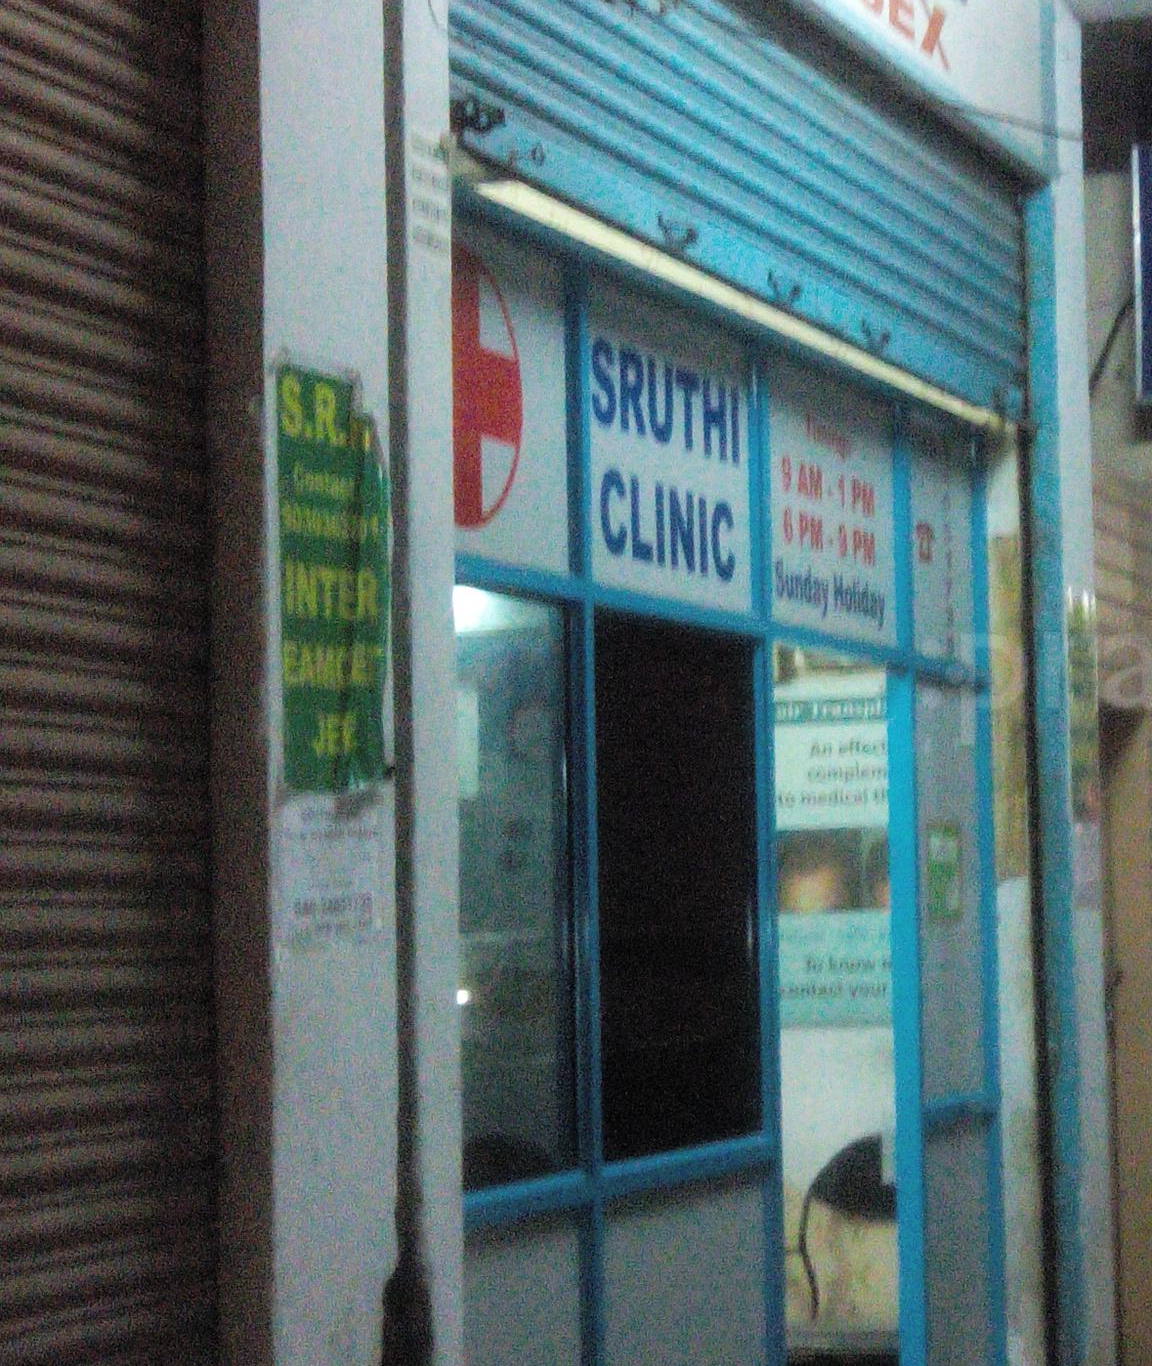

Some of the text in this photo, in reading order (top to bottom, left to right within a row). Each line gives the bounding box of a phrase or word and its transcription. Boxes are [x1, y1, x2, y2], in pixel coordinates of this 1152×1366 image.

[591, 338, 741, 466] SRUTHI
[600, 468, 736, 583] CLINIC
[797, 459, 824, 502] AM
[838, 473, 846, 510] 1
[852, 477, 875, 518] PM
[798, 511, 824, 553] PM
[853, 528, 876, 569] PM
[775, 556, 886, 632] Sunday Holiday
